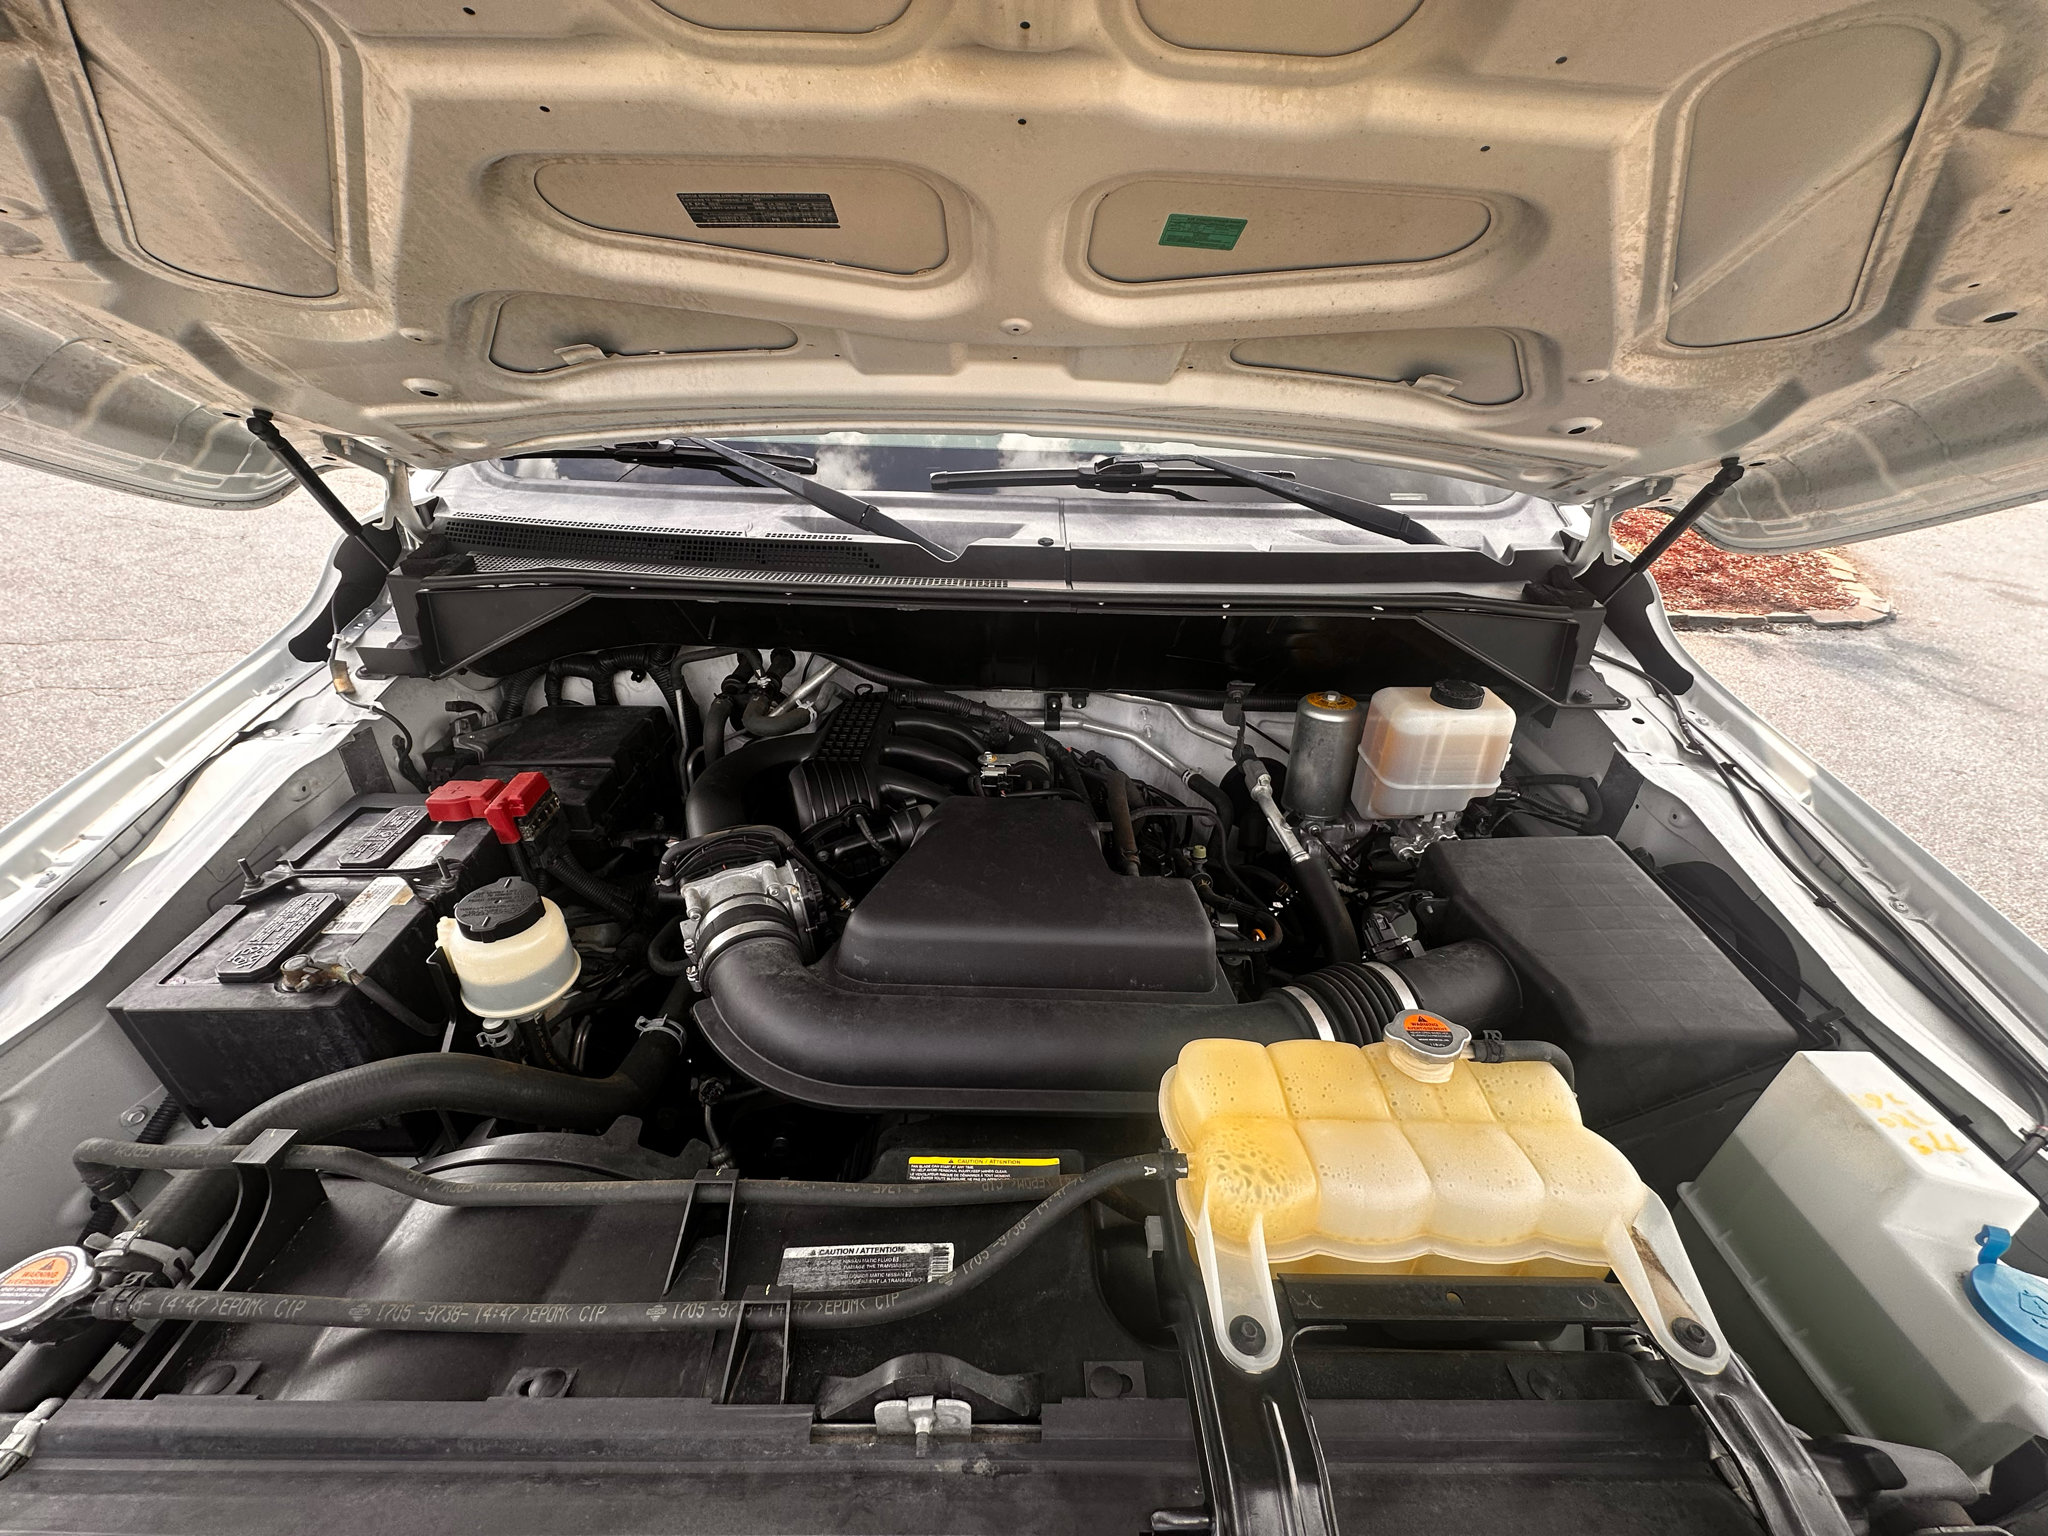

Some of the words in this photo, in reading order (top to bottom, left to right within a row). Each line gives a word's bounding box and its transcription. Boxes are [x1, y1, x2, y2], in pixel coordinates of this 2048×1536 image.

[819, 1248, 853, 1256] CAUTION
[859, 1246, 905, 1255] ATTENTION
[273, 1299, 306, 1318] CIP
[376, 1303, 412, 1321] 1705
[578, 1305, 608, 1323] CIP
[672, 1302, 705, 1320] 1705
[874, 1293, 900, 1310] CIP
